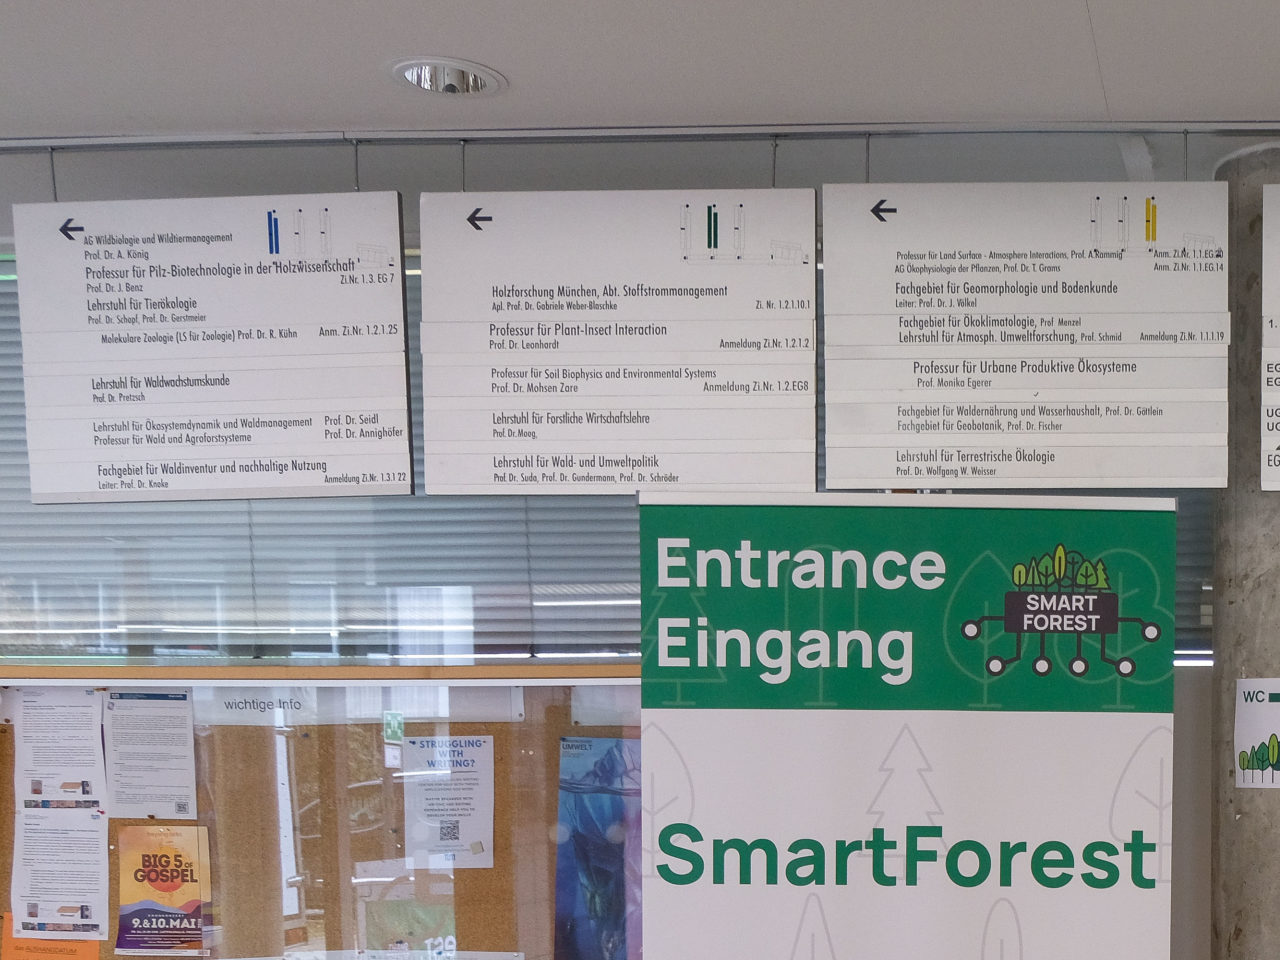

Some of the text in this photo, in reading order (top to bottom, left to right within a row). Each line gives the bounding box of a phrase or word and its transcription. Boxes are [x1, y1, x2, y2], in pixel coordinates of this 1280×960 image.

[86, 266, 129, 279] Professur
[132, 265, 146, 278] für
[149, 263, 241, 278] Pilz-Biotechnologie
[244, 263, 253, 275] in
[256, 261, 272, 274] der
[492, 284, 728, 298] Holzforschung München, Abt. Stoffstrommanagement
[896, 281, 1118, 296] Fachgebiet für Geomorphologie und Bodenkunde
[87, 297, 197, 311] Lehrstuhl für Tierökologie
[490, 323, 667, 336] Professur für Plant-Insect Interaction
[1268, 319, 1277, 328] 1.
[914, 358, 1137, 375] Professur für Urbane Produktive Ökosysteme
[491, 367, 716, 381] Professur für Soil Biophysics and Environmental Systems
[92, 374, 230, 390] Lehrstuhl für Waldwachstumskunde
[703, 381, 809, 394] Anmeldung Zi.Nr. 1.2.EG8
[325, 413, 379, 426] Prof. Dr. Seidl
[492, 411, 650, 425] Lehrstuhl für Forstliche Wirtschaftslehre
[324, 426, 403, 439] Prof. Dr. Annighöfer
[493, 455, 659, 469] Lehrstuhl für Wald- und Umweltpolitik
[896, 448, 1055, 464] Lehrstuhl für Terrestrische Ökologie
[1267, 454, 1280, 467] EG
[98, 460, 327, 478] Fachgebiet für Waldinventur und nachhaltige Nutzung
[656, 538, 946, 588] Entrance
[1026, 594, 1097, 612] SMART
[1023, 614, 1100, 632] FOREST
[657, 617, 914, 685] Eingang
[1243, 690, 1265, 702] WC
[224, 698, 302, 712] wichtige Info
[420, 740, 482, 748] STRUGGLING
[562, 743, 592, 751] UMWELT
[427, 760, 476, 768] WRITING?
[142, 854, 170, 868] BIG
[174, 855, 182, 868] 5
[656, 823, 1156, 889] SmartForest
[134, 868, 198, 882] GOSPEL
